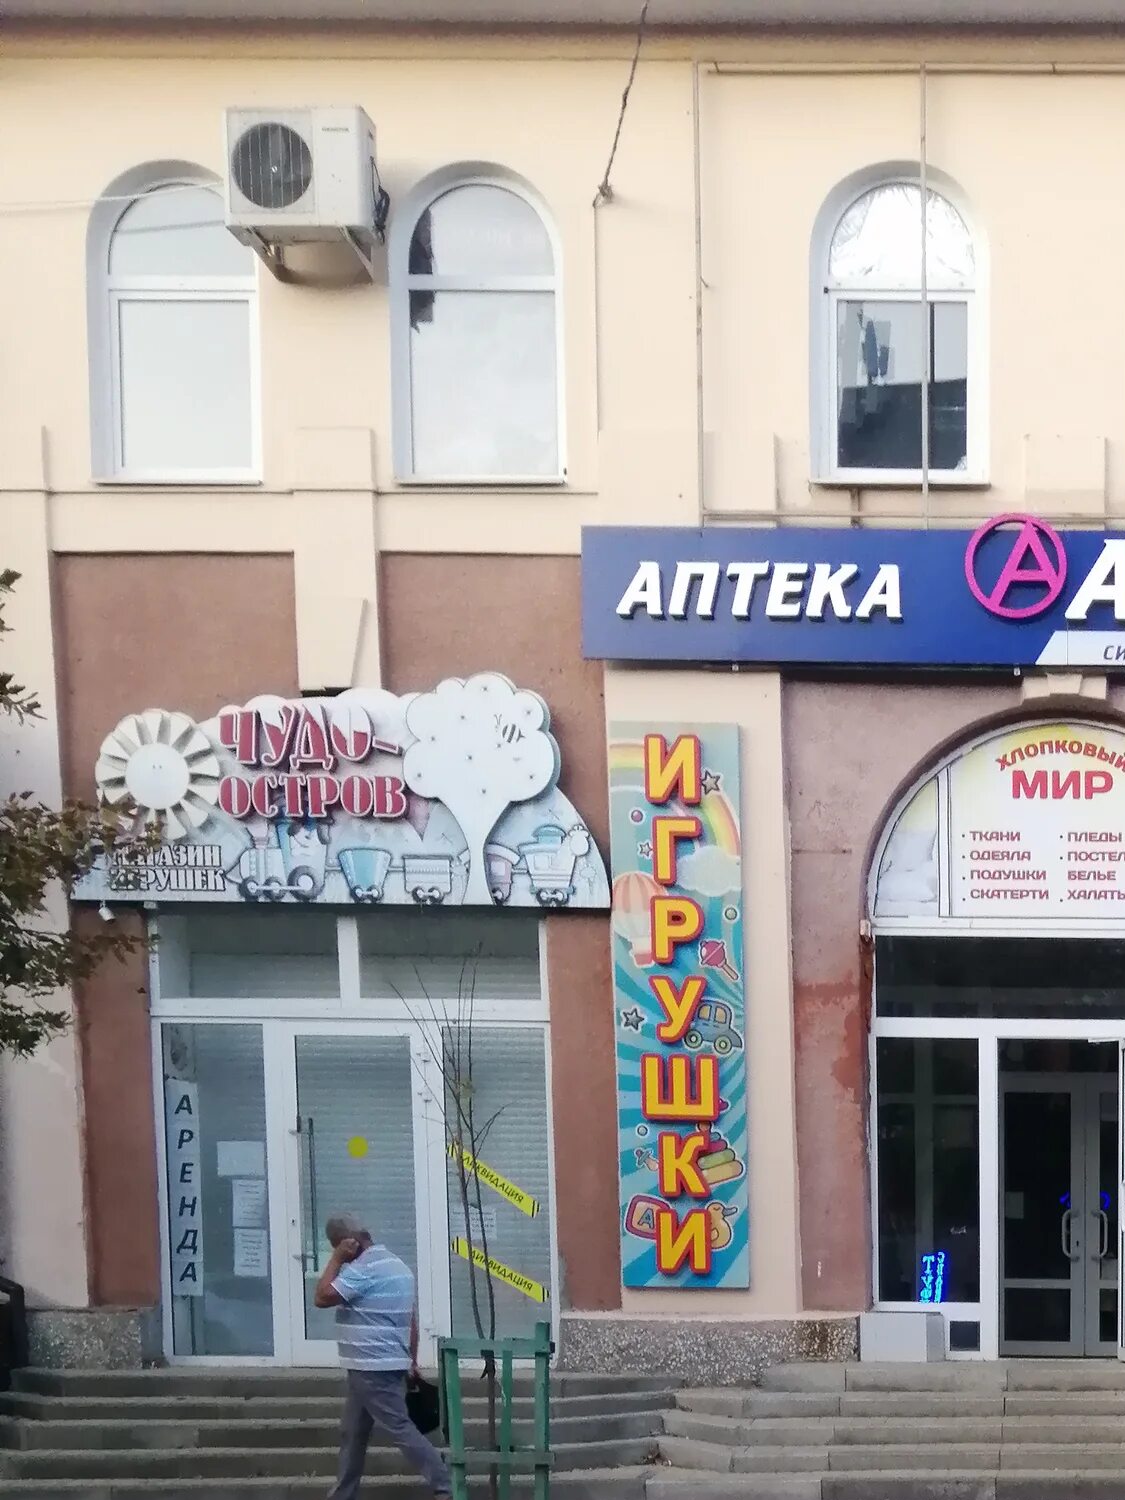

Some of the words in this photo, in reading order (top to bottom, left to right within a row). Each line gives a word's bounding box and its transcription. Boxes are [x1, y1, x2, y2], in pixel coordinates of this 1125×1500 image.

[616, 561, 902, 621] АПТЕКА
[218, 704, 401, 770] ЧУДО-
[1012, 770, 1114, 800] МИР
[218, 774, 406, 818] ОСТРОВ
[970, 831, 1021, 842] ТКАНИ
[1067, 832, 1122, 842] ПЛЕДЫ
[969, 850, 1031, 861] ОДЕЯЛА
[970, 870, 1047, 881] ПОДУШКИ
[1067, 870, 1117, 881] БЕЛЬЕ
[970, 889, 1049, 900] СКАТЕРТИ
[641, 734, 719, 1275] ИГРУШКИ
[174, 1094, 198, 1283] АРЕНДА
